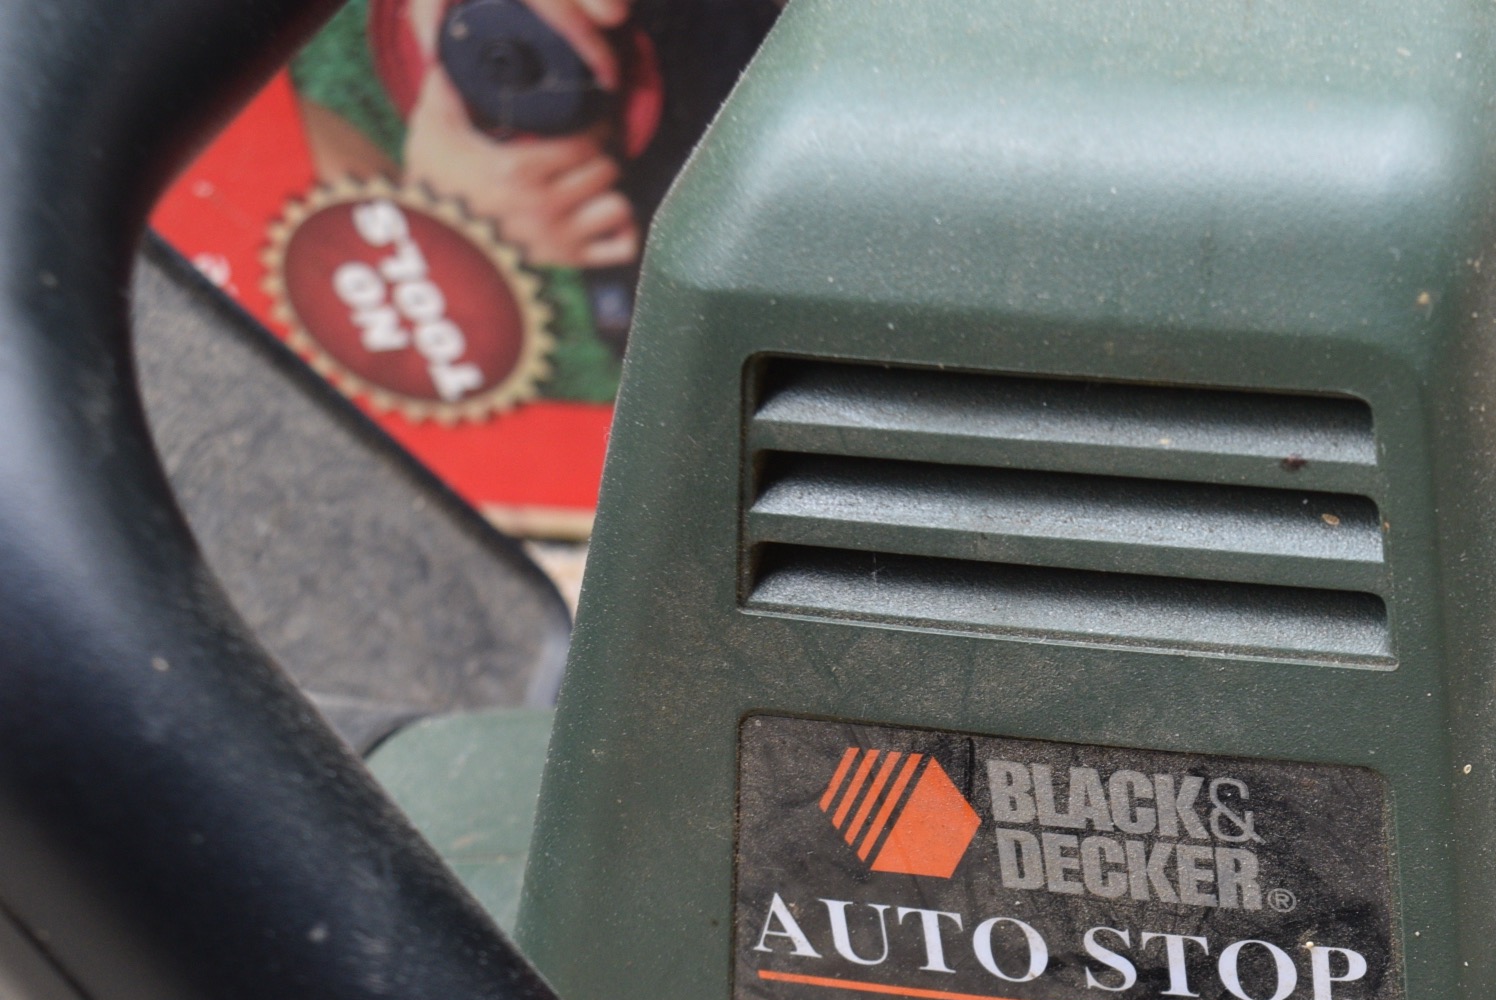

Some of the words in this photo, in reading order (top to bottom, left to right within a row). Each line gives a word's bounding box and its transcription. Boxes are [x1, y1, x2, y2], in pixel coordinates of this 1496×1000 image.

[332, 262, 407, 352] NO
[353, 202, 484, 400] TOOLS
[753, 892, 1049, 983] AUTO
